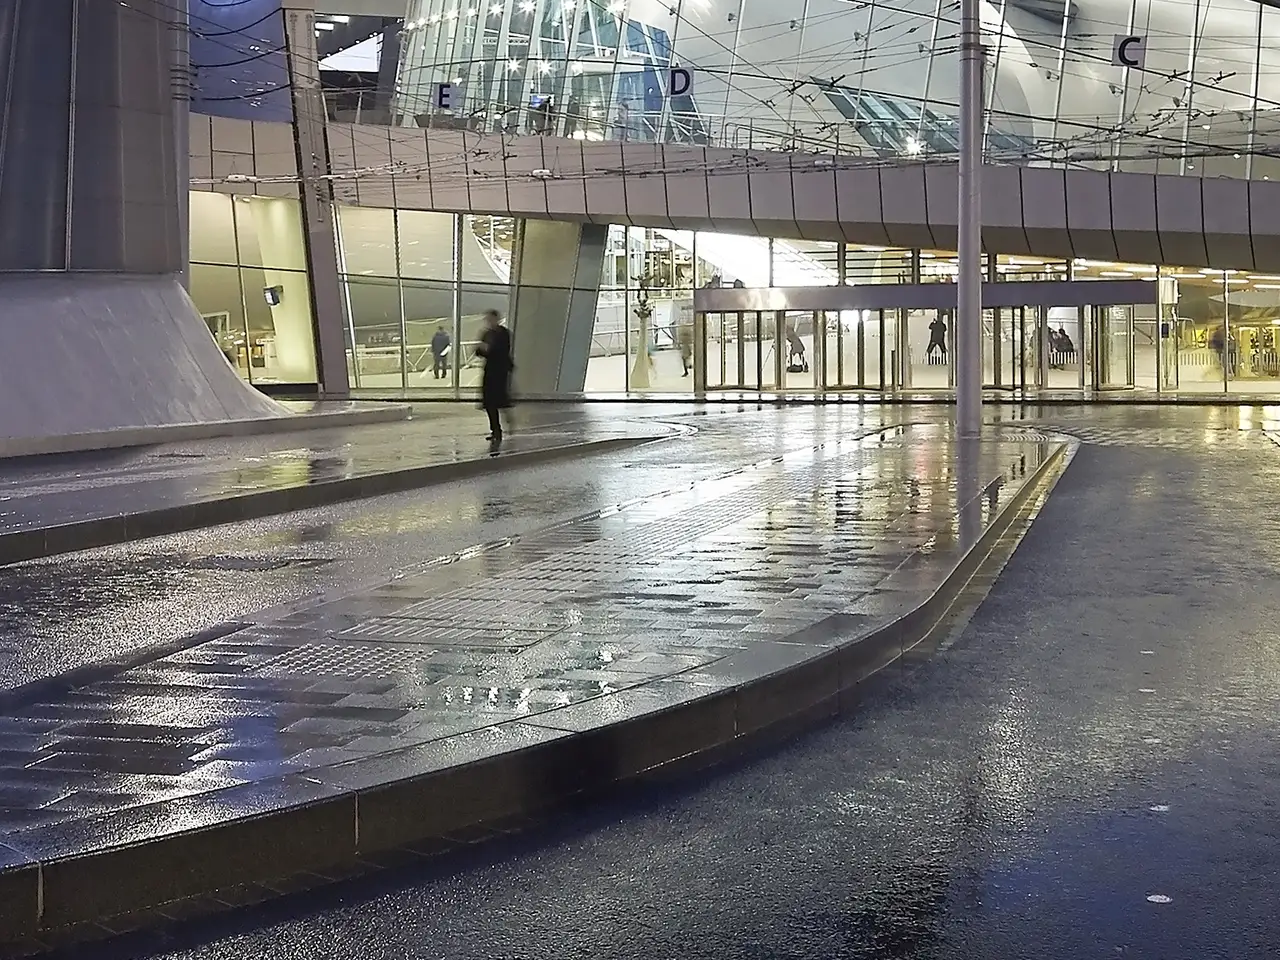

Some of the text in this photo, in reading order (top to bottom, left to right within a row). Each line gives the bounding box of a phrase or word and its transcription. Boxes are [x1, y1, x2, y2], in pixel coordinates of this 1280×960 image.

[1118, 37, 1141, 66] C
[670, 69, 691, 95] D
[438, 84, 451, 109] E
